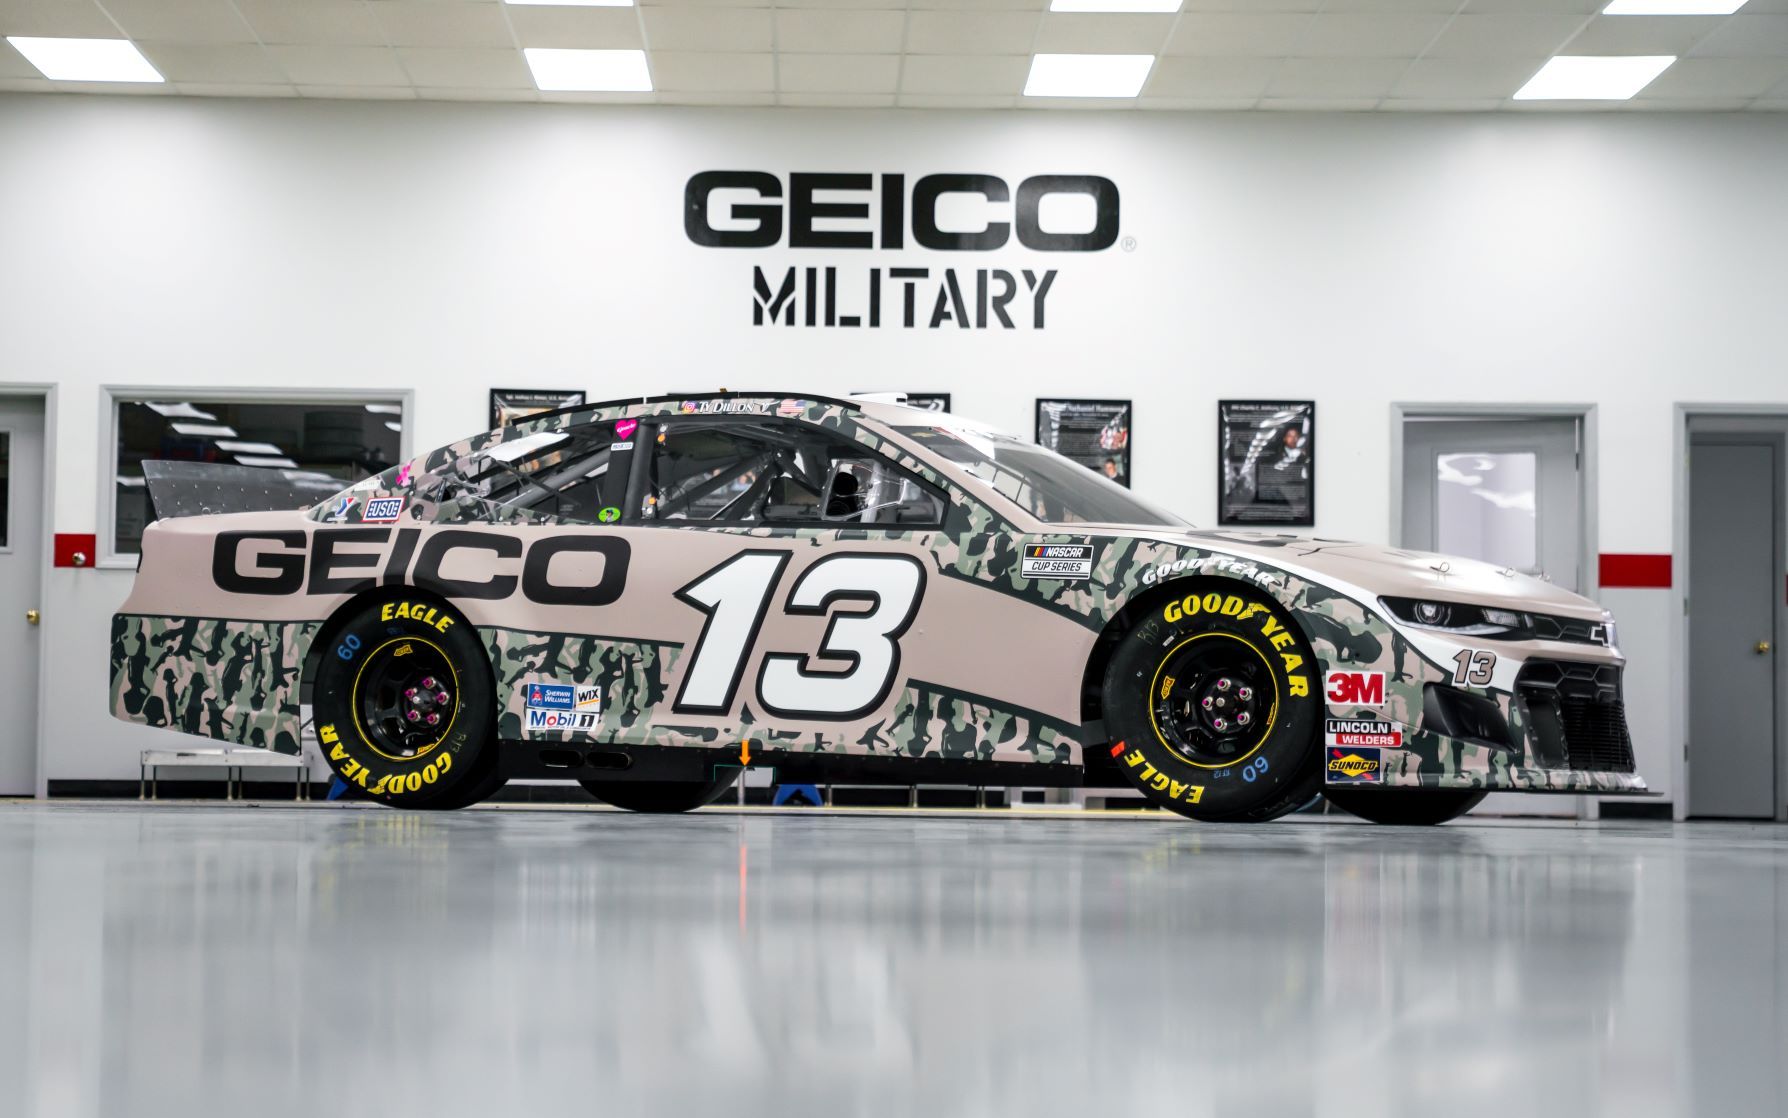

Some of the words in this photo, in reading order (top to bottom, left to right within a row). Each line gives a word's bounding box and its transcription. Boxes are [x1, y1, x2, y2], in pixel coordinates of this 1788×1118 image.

[684, 170, 1120, 252] GEICO
[753, 265, 1059, 330] MILITARY
[371, 501, 395, 517] USO
[212, 527, 632, 606] GEICO
[1032, 561, 1050, 572] CUP
[1051, 561, 1082, 572] SERIES
[1045, 547, 1084, 558] NASCAR
[381, 602, 455, 634] EAGLE
[671, 548, 928, 722] 13
[1163, 593, 1309, 698] GOODYEAR
[1453, 649, 1498, 686] 13
[578, 688, 599, 702] WIX
[1327, 673, 1384, 704] 3M
[530, 710, 577, 726] Mobil
[1329, 721, 1388, 734] LINCOLN
[1342, 735, 1395, 745] WELDERS
[319, 723, 452, 795] GOODYEAR
[1330, 760, 1377, 771] SUNOCO
[1124, 749, 1205, 804] EAGLE
